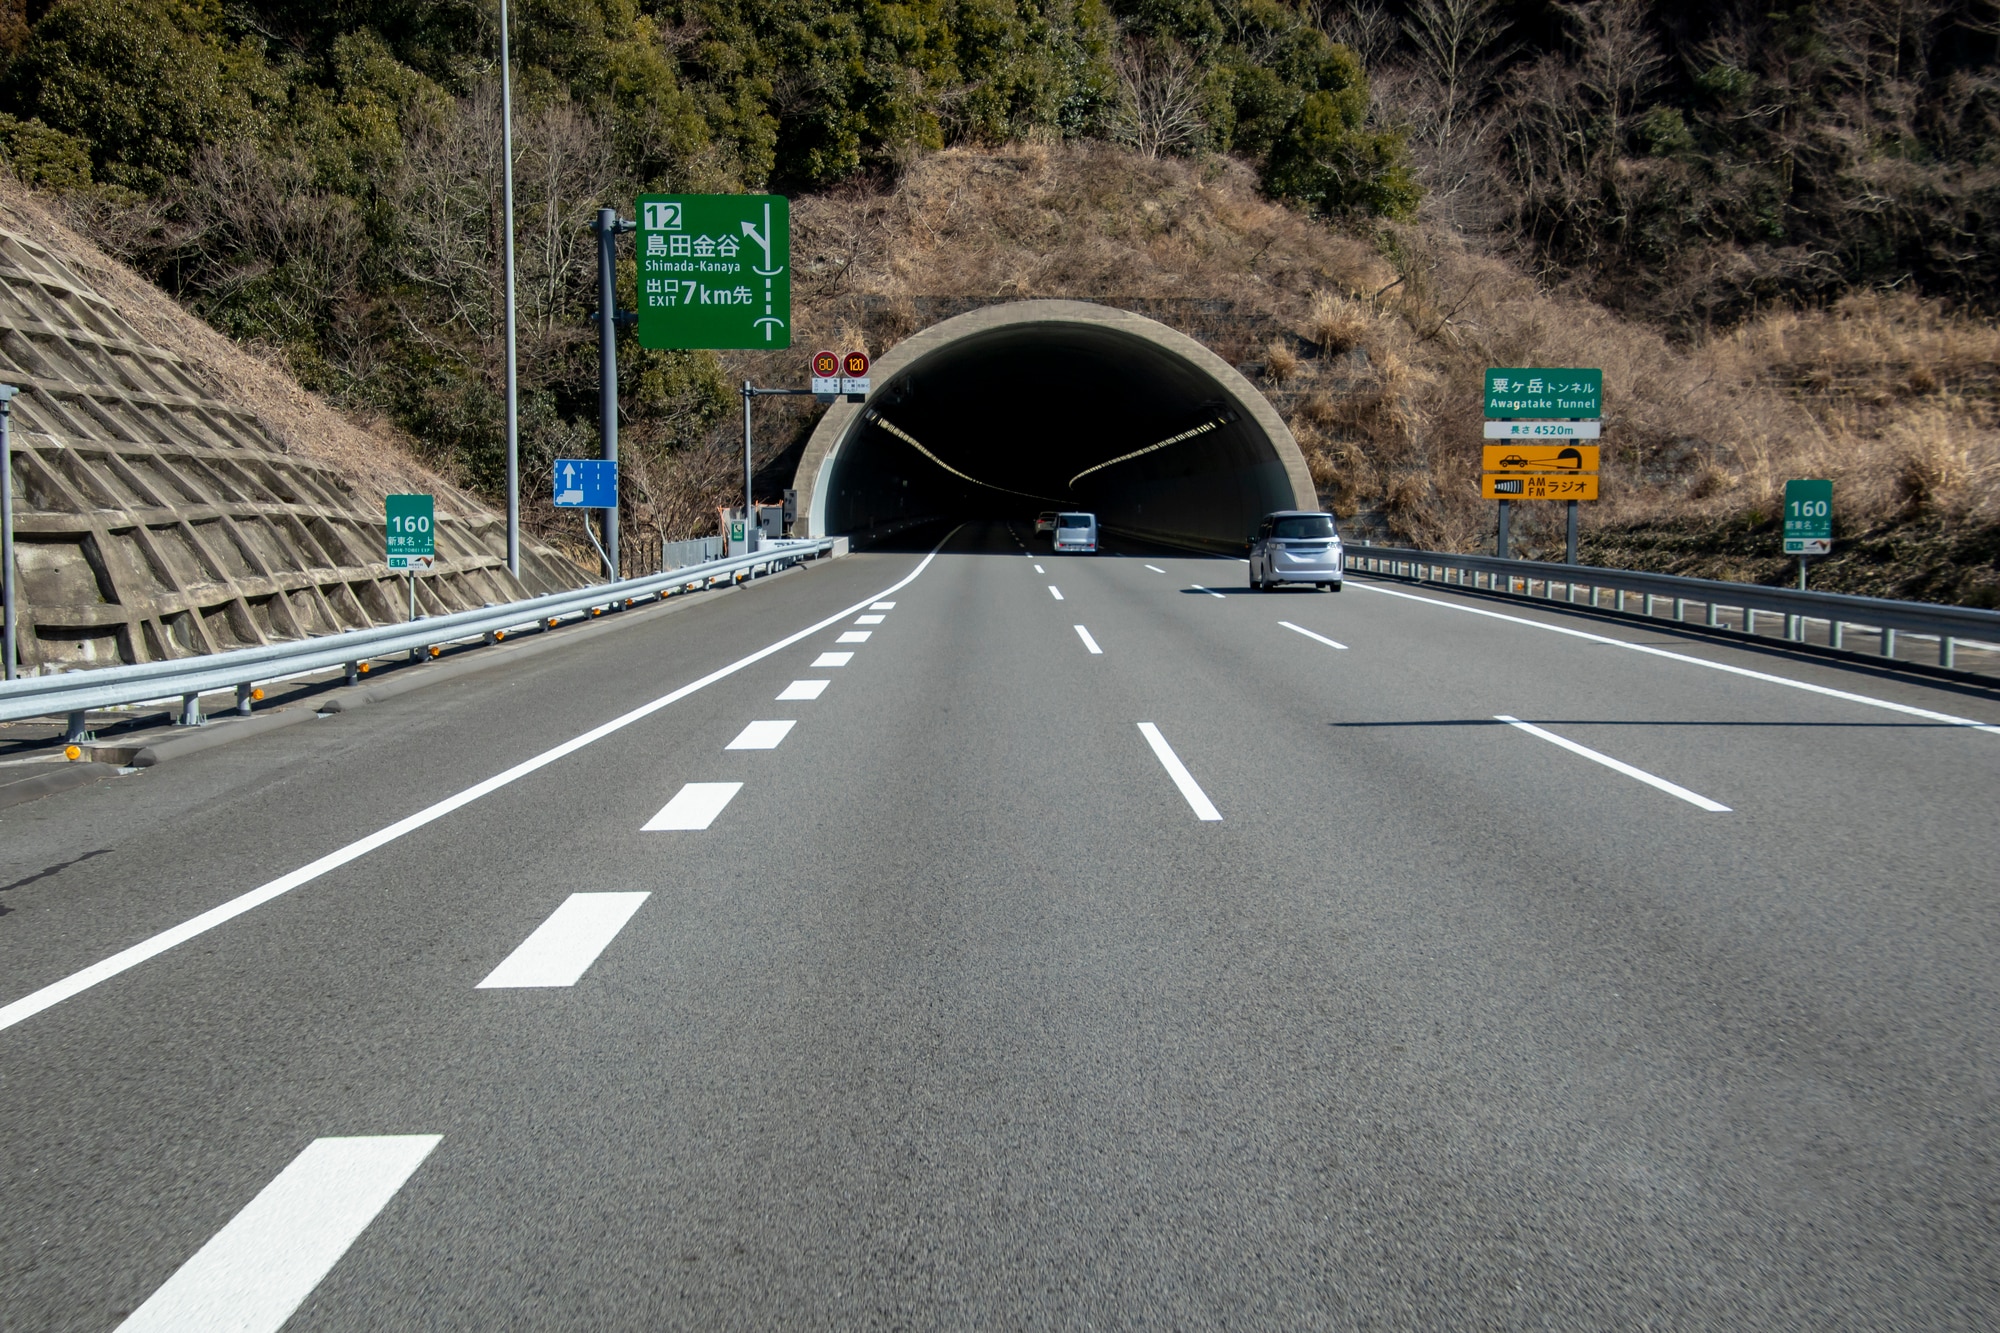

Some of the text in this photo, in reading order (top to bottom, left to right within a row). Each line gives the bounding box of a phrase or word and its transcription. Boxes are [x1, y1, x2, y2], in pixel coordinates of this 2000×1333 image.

[646, 204, 681, 229] 12
[646, 233, 740, 258] 島田金谷
[645, 260, 740, 275] Shimada-Kanaya
[646, 278, 679, 293] 出口
[649, 295, 677, 306] EXIT
[818, 358, 834, 371] 80
[849, 358, 864, 371] 120
[1490, 398, 1595, 410] Awagatake Tunnel
[1528, 477, 1546, 487] AM
[1548, 481, 1587, 493] ラジオ
[1528, 487, 1546, 497] FM
[1791, 500, 1827, 517] 160
[392, 515, 430, 533] 160
[390, 559, 407, 567] E1A
